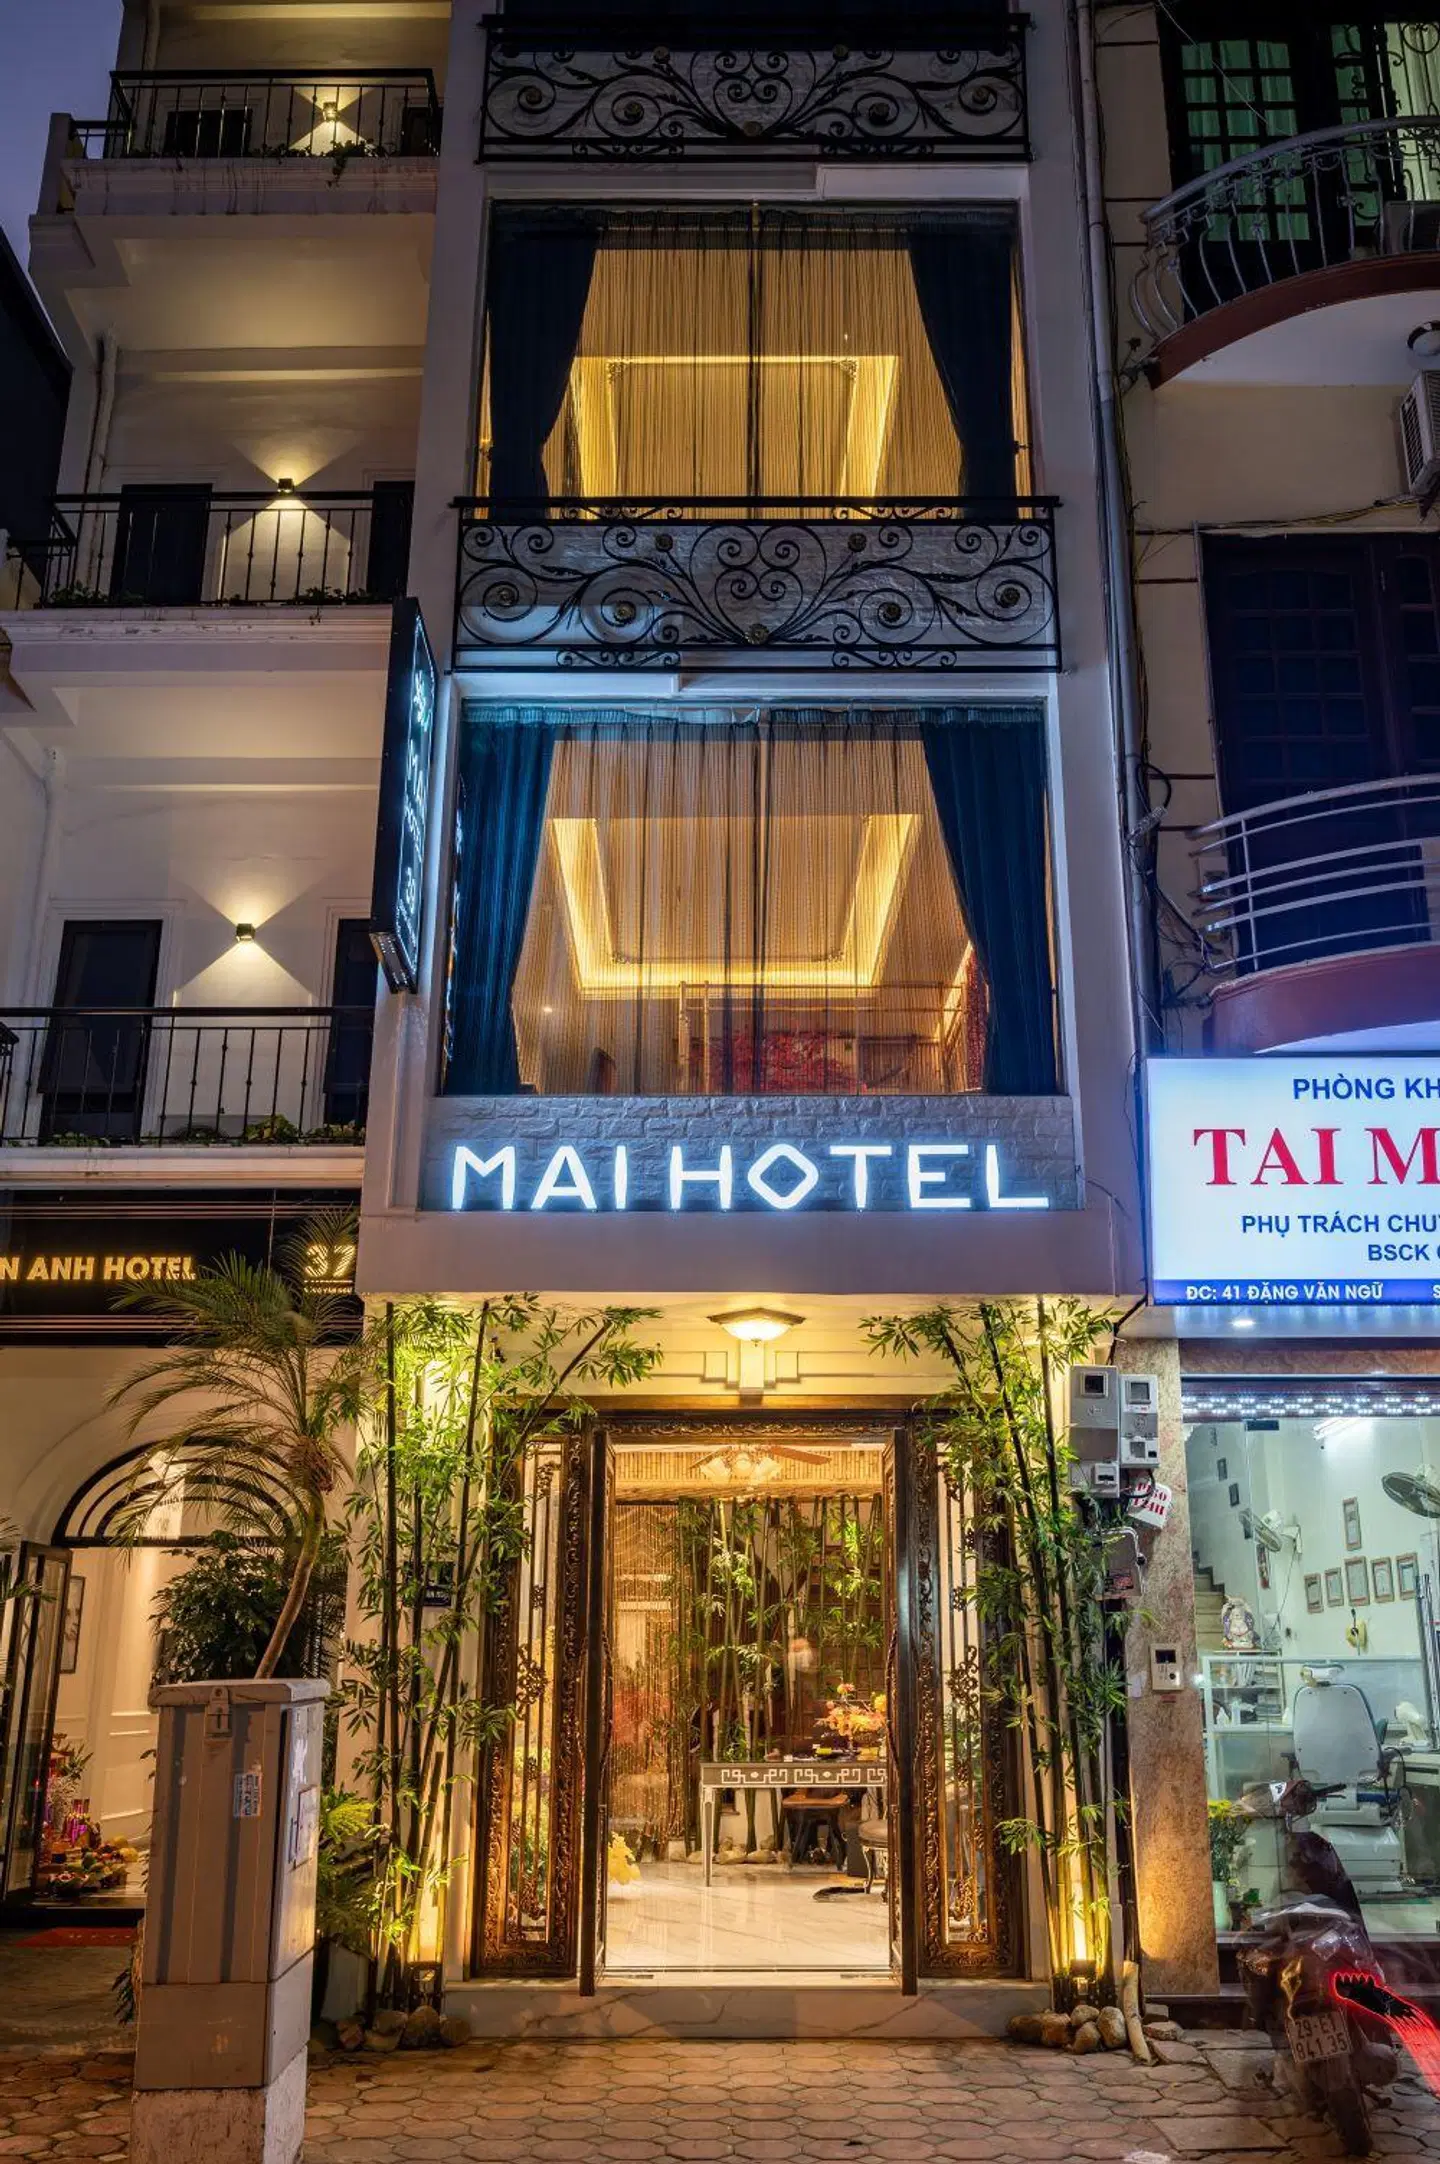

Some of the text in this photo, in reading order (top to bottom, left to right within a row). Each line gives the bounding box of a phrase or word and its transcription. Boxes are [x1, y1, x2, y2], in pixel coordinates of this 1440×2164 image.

[1293, 1073, 1395, 1100] PHÒNG
[1193, 1127, 1440, 1185] TAI M
[452, 1143, 1050, 1209] MAI HOTEL
[1241, 1214, 1290, 1238] PHỤ
[1298, 1211, 1380, 1233] TRÁCH
[305, 1244, 356, 1277] 37
[1367, 1243, 1430, 1261] BSCK
[26, 1256, 95, 1281] ANH
[103, 1256, 196, 1281] HOTEL
[1186, 1285, 1218, 1300] ĐC:
[1222, 1285, 1241, 1300] 41
[1247, 1282, 1299, 1304] ĐẶNG
[1304, 1281, 1340, 1300] VĂN
[1344, 1281, 1384, 1300] NGỮ
